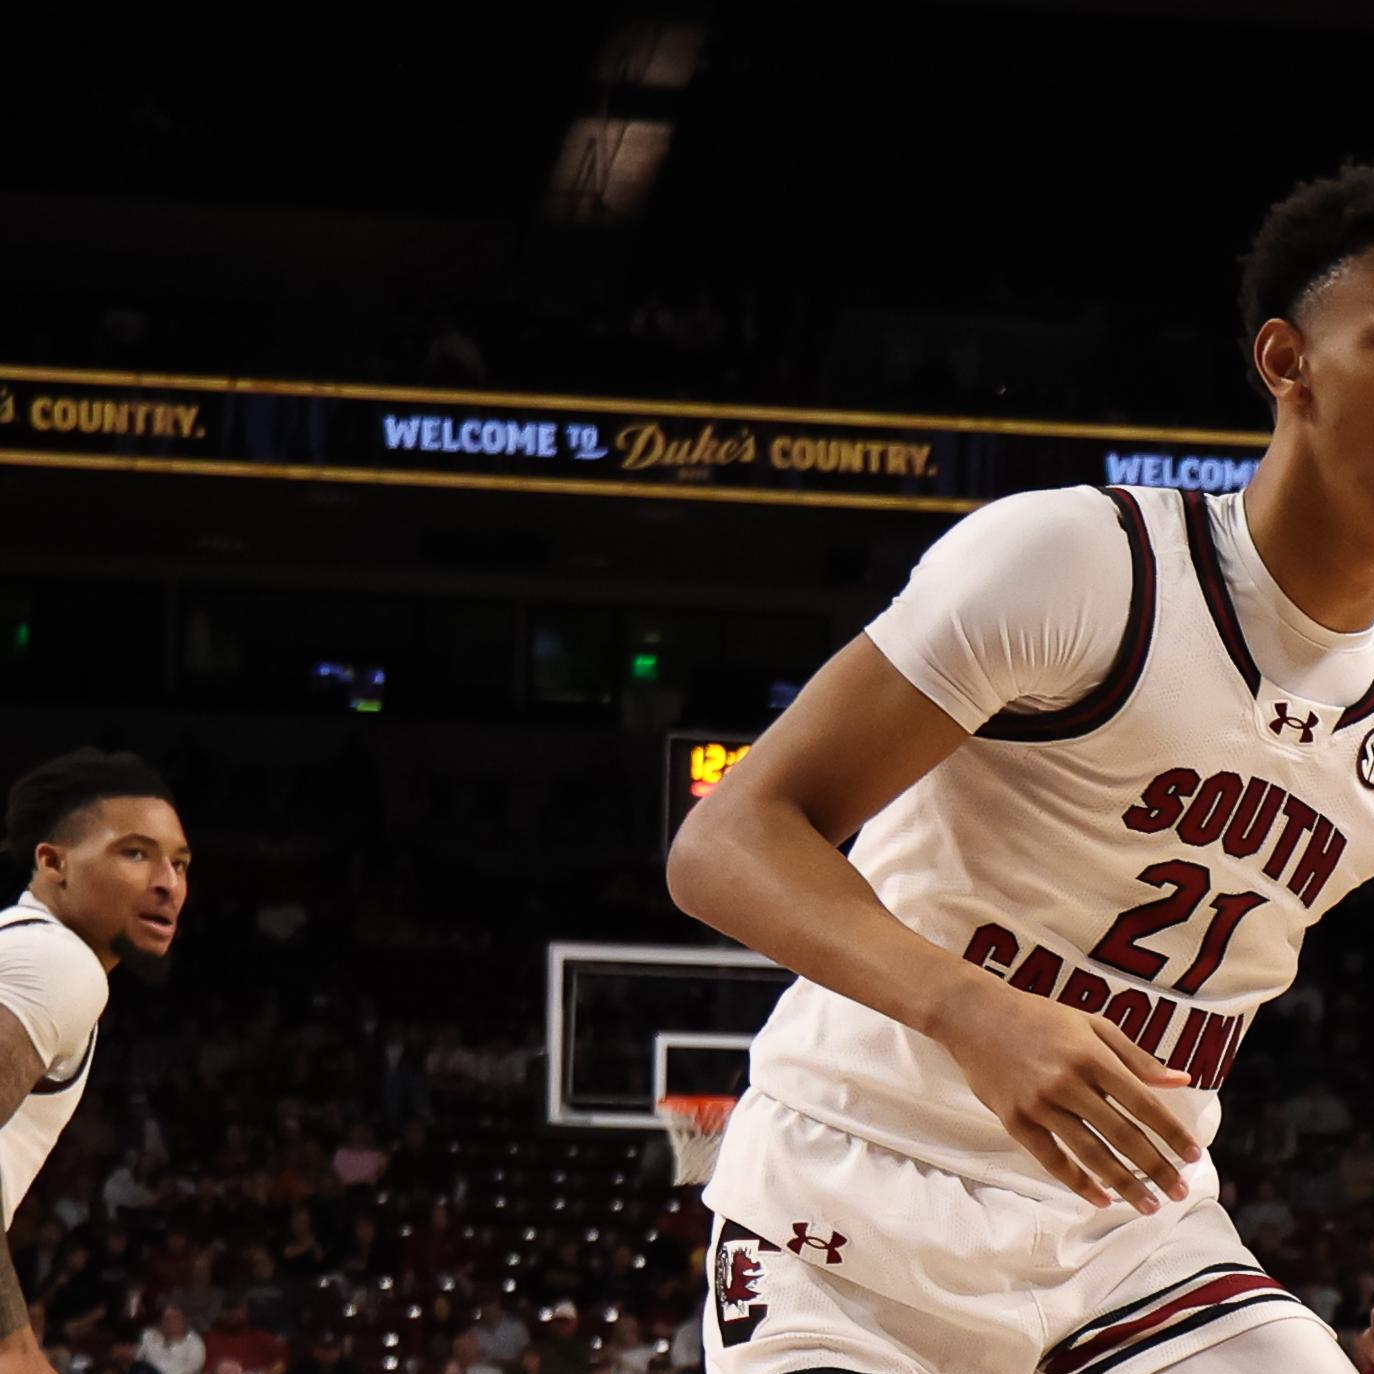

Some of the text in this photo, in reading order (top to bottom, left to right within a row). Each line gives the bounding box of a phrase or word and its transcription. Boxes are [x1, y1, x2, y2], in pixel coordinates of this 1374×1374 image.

[31, 396, 206, 438] COUNTRY.
[384, 414, 937, 476] WELCOME TO Duke's COUNTRY.
[1105, 453, 1259, 490] WELCOM
[1121, 767, 1348, 910] SOUTH
[1087, 858, 1271, 997] 21
